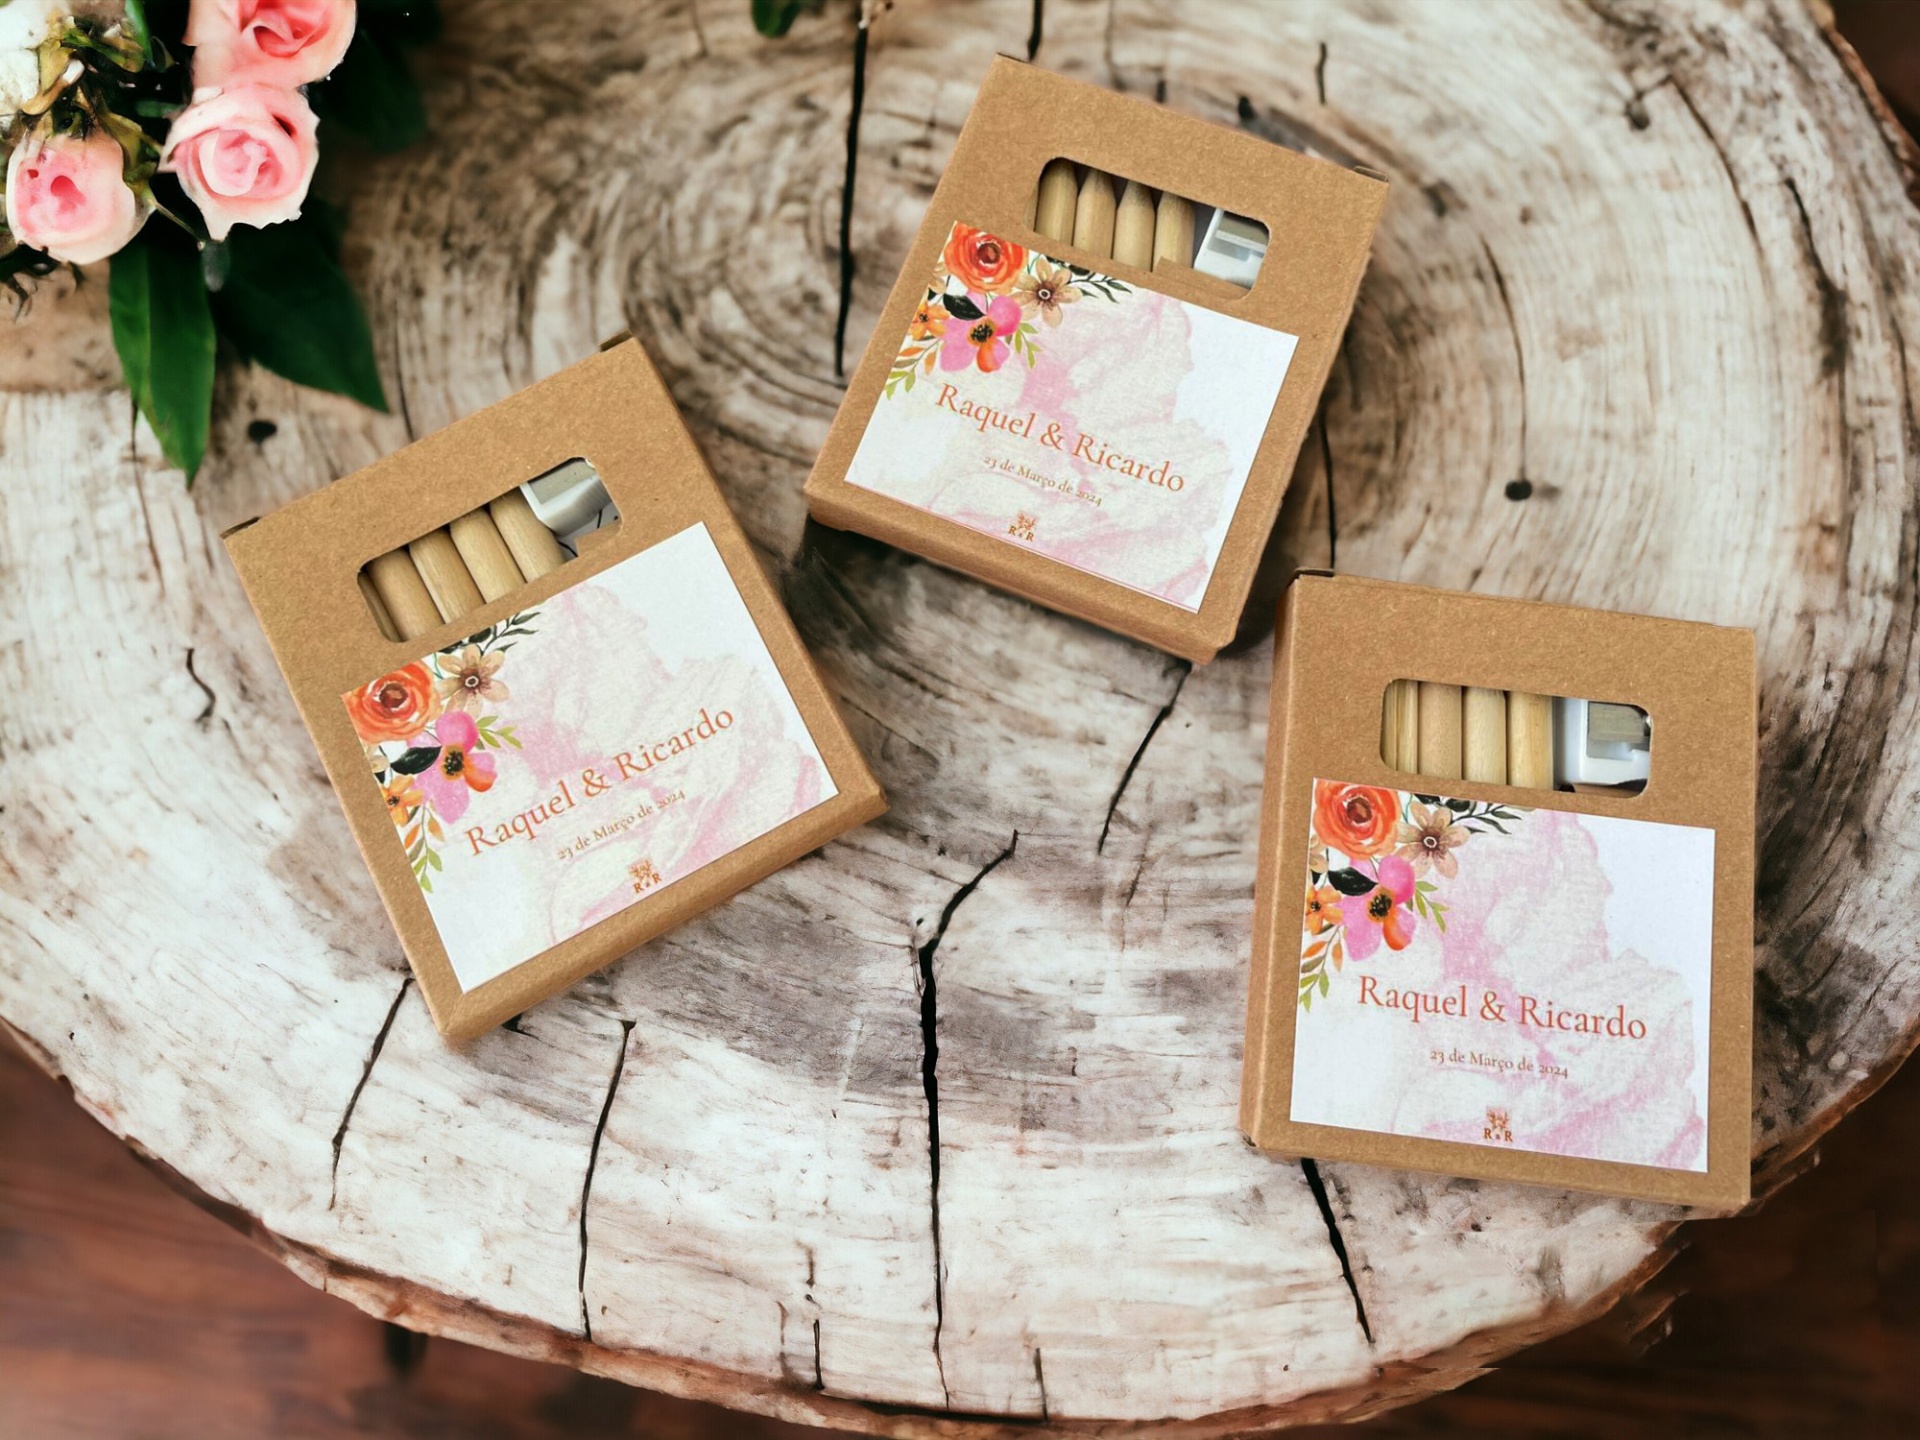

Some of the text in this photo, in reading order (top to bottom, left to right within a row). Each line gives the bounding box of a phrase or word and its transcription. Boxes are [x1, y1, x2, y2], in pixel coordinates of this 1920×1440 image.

[935, 383, 1185, 492] Raquel & Ricardo
[983, 456, 1102, 507] 23 de Março de 2024
[1008, 525, 1017, 535] R
[1026, 531, 1034, 541] R
[464, 708, 734, 856] Raquel & Ricardo
[558, 789, 685, 860] 23 de Março de 2024
[633, 882, 644, 894] R
[651, 872, 662, 884] R
[1357, 975, 1647, 1040] Raquel & Ricardo
[1430, 1048, 1569, 1079] 23 de Março de 2024
[1483, 1127, 1492, 1140] R
[1504, 1130, 1513, 1142] R
